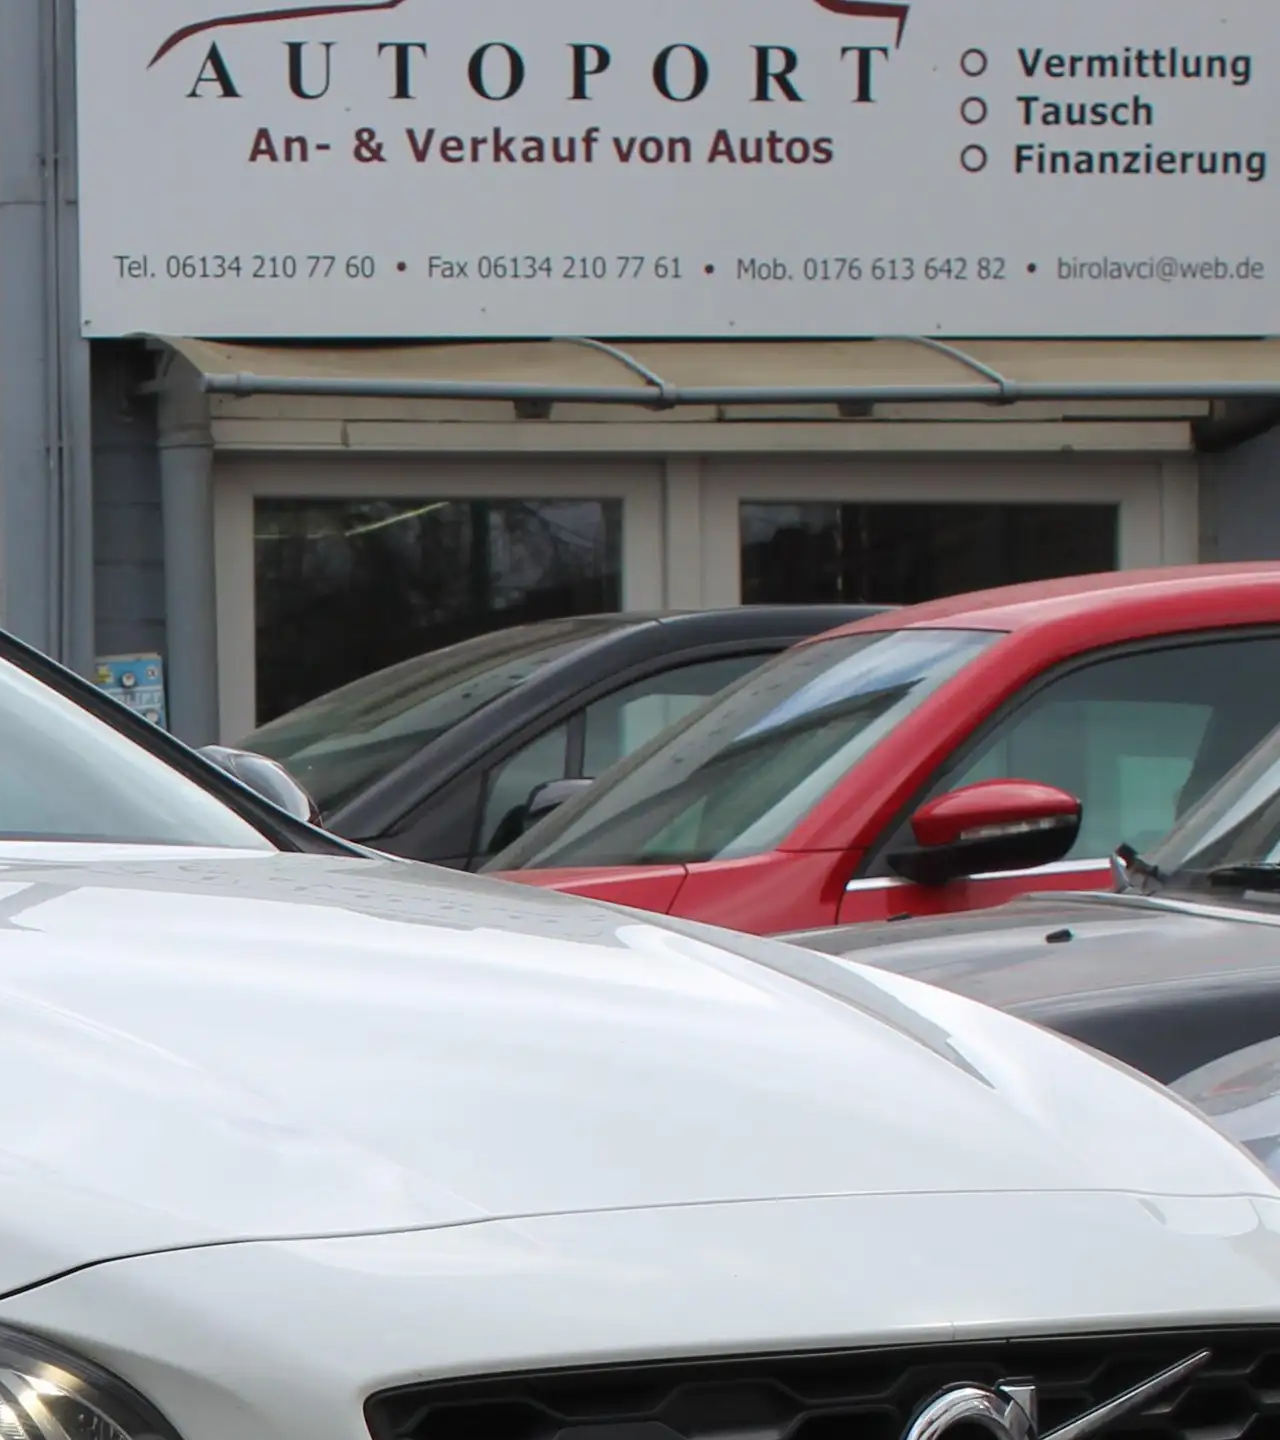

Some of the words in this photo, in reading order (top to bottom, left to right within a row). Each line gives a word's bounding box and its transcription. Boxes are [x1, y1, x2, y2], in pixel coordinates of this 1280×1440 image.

[185, 40, 890, 103] AUTOPORT
[1017, 47, 1252, 86] Vermittlung
[1016, 94, 1153, 126] Tausch
[248, 128, 331, 163] An-
[353, 127, 387, 163] &
[406, 127, 598, 164] Verkauf
[613, 136, 692, 164] von
[708, 128, 834, 165] Autos
[1014, 142, 1267, 183] Finanzierung
[113, 255, 157, 279] Tel.
[166, 255, 242, 278] 06134
[252, 255, 297, 278] 210
[307, 255, 336, 278] 77
[345, 255, 375, 279] 60
[428, 255, 468, 279] Fax
[477, 255, 553, 279] 06134
[562, 256, 607, 279] 210
[617, 256, 645, 278] 77
[654, 256, 682, 279] 61
[737, 257, 793, 281] Mob.
[803, 257, 862, 281] 0176
[871, 257, 915, 281] 613
[924, 257, 967, 281] 642
[977, 256, 1005, 280] 82
[1057, 256, 1265, 282] birolavci@web.de
